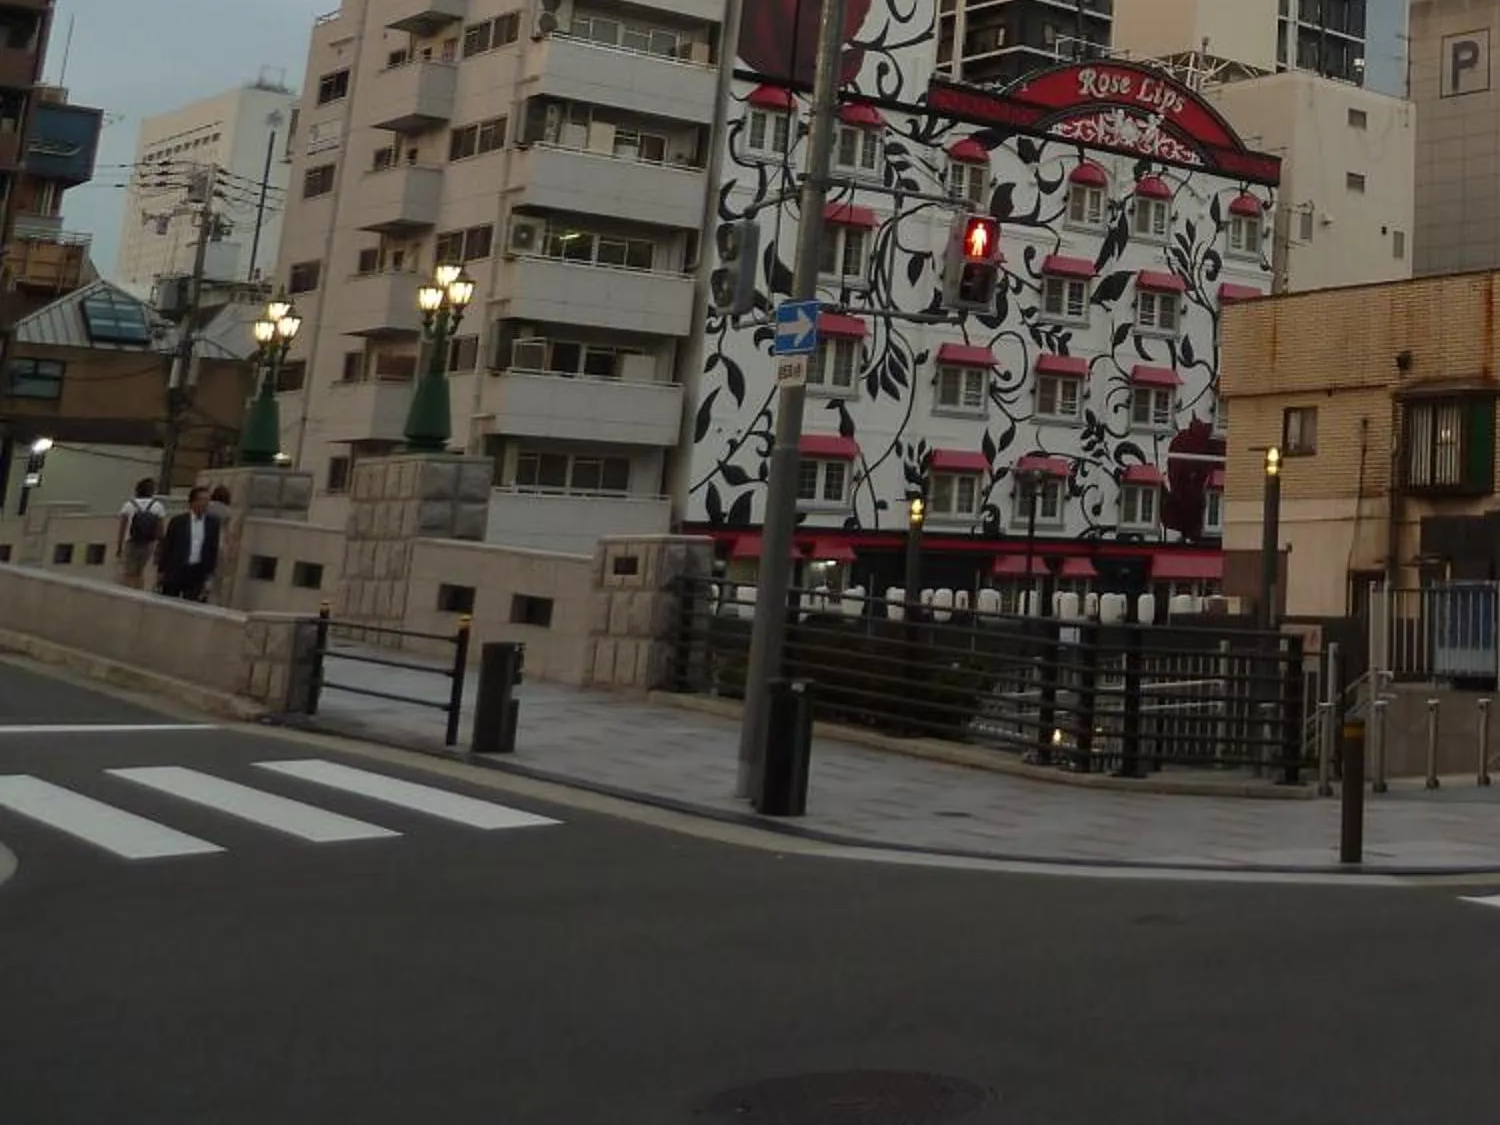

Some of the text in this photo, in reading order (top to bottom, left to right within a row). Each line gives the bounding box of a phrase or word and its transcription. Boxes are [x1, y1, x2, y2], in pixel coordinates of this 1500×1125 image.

[1077, 67, 1185, 112] Rose Lips
[1452, 40, 1479, 92] P
